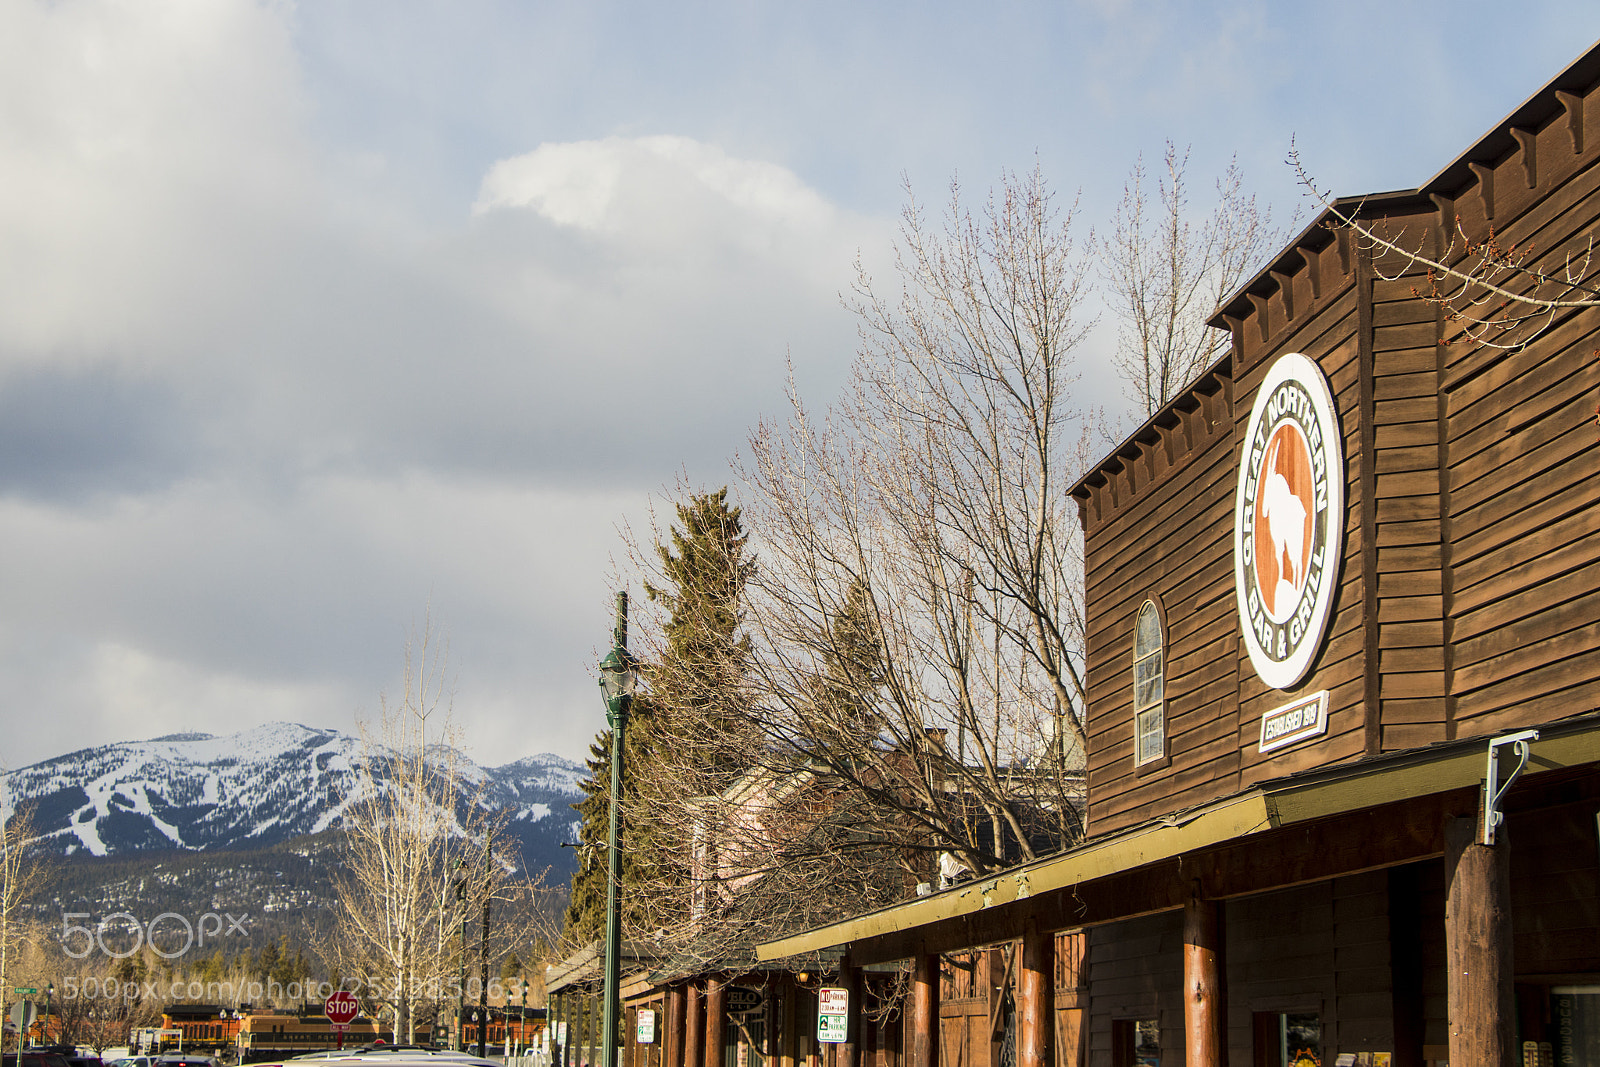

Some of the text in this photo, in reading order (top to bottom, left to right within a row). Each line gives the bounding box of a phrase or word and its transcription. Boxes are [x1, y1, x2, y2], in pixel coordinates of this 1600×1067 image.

[1243, 386, 1328, 567] GREAT NORTHERN
[1248, 546, 1324, 659] BAR & GRILL
[1264, 709, 1303, 740] ESTABLISHED
[327, 1001, 356, 1014] STOP
[821, 991, 830, 1002] NO
